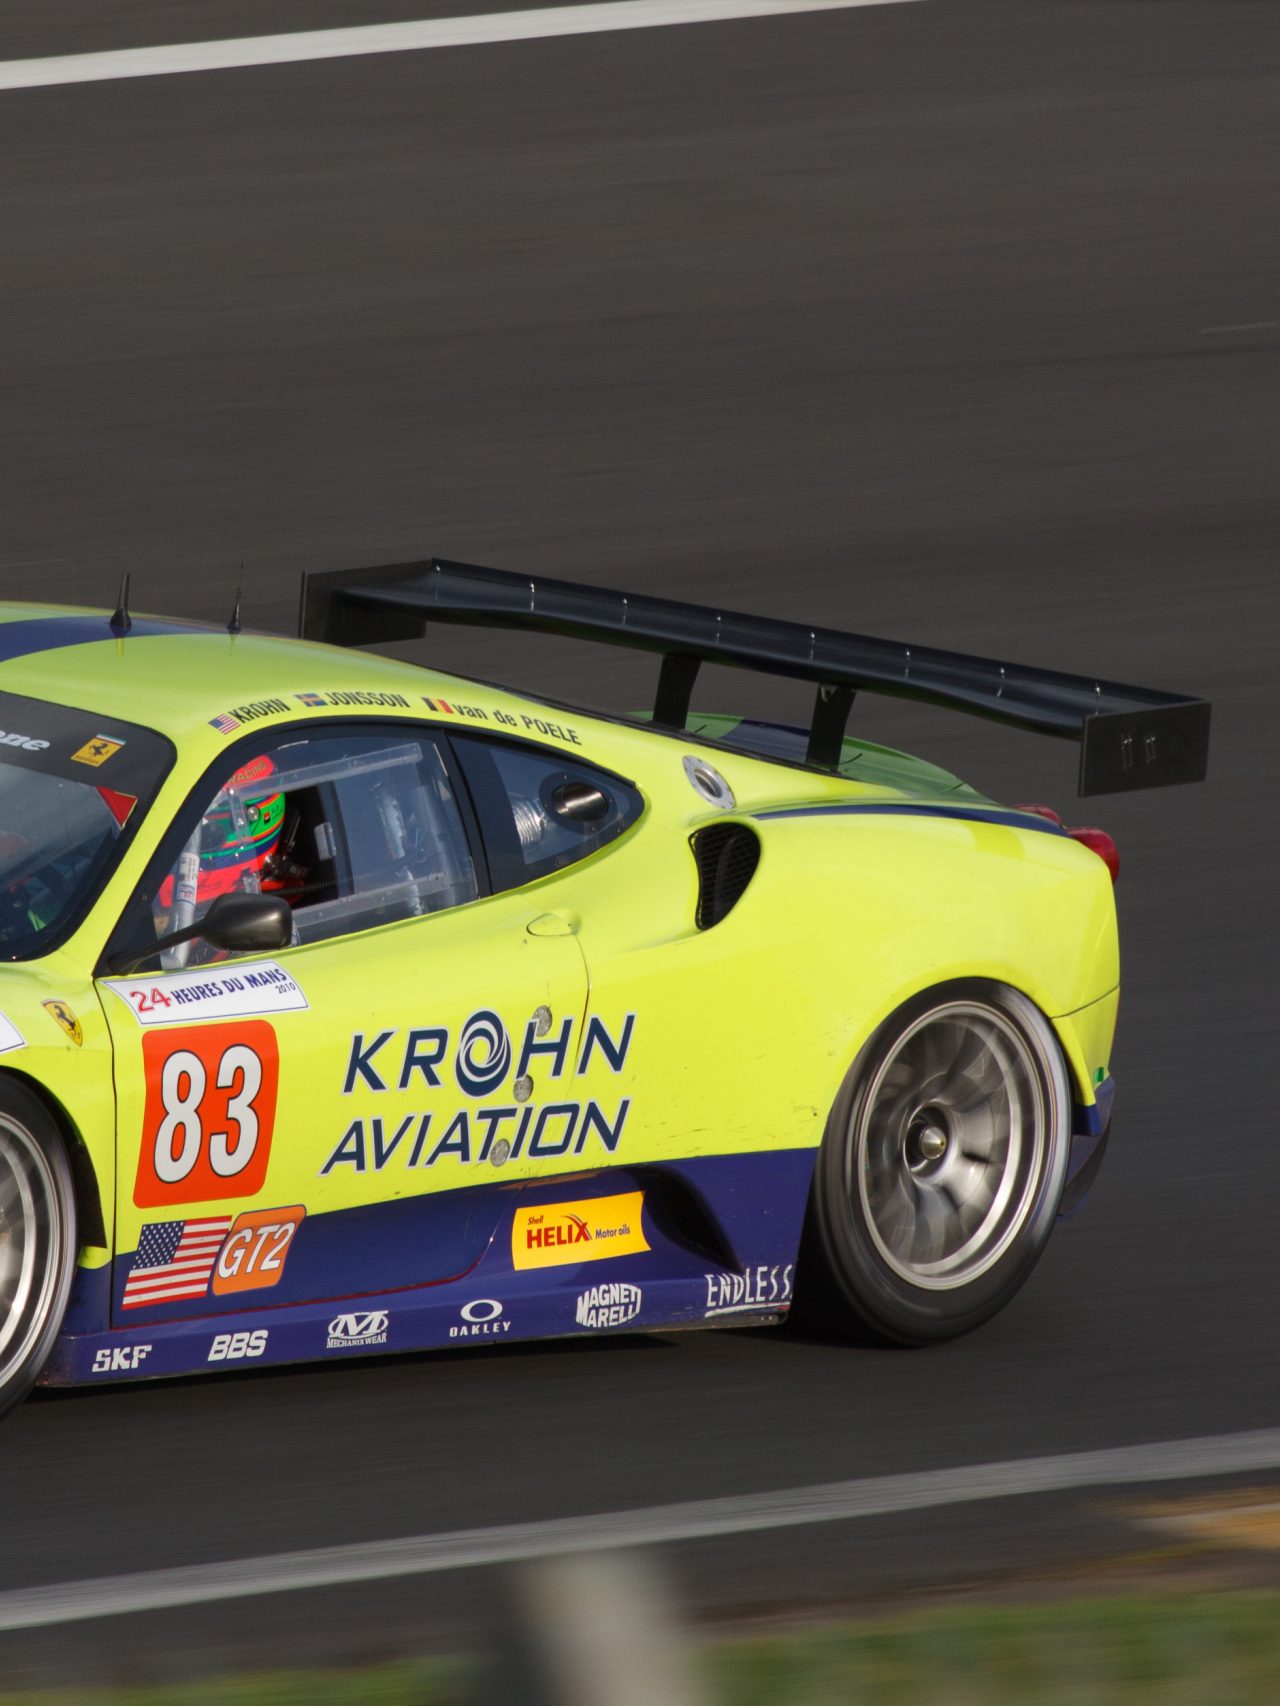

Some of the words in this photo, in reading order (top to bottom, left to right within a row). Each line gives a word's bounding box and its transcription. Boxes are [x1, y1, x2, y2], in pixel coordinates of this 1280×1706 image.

[227, 697, 292, 725] KROHN
[327, 691, 411, 709] JONSSON
[453, 703, 489, 721] van
[495, 708, 518, 727] de
[520, 714, 583, 747] POELE
[130, 988, 171, 1013] 24
[171, 982, 224, 1005] HEURES
[221, 978, 245, 994] DU
[247, 968, 288, 989] MANS
[274, 981, 297, 995] 2010
[340, 1006, 639, 1098] KROHN
[153, 1044, 263, 1185] 83
[316, 1097, 633, 1177] AVIATION
[526, 1214, 591, 1249] HELIX
[594, 1227, 618, 1240] Motor
[618, 1223, 631, 1236] oils
[527, 1214, 545, 1226] Shell
[218, 1221, 296, 1279] GT2
[207, 1329, 269, 1362] BBS
[326, 1336, 365, 1349] MECHANIX
[364, 1331, 388, 1346] WEAR
[449, 1320, 511, 1338] OAKLEY
[91, 1344, 153, 1373] SKF
